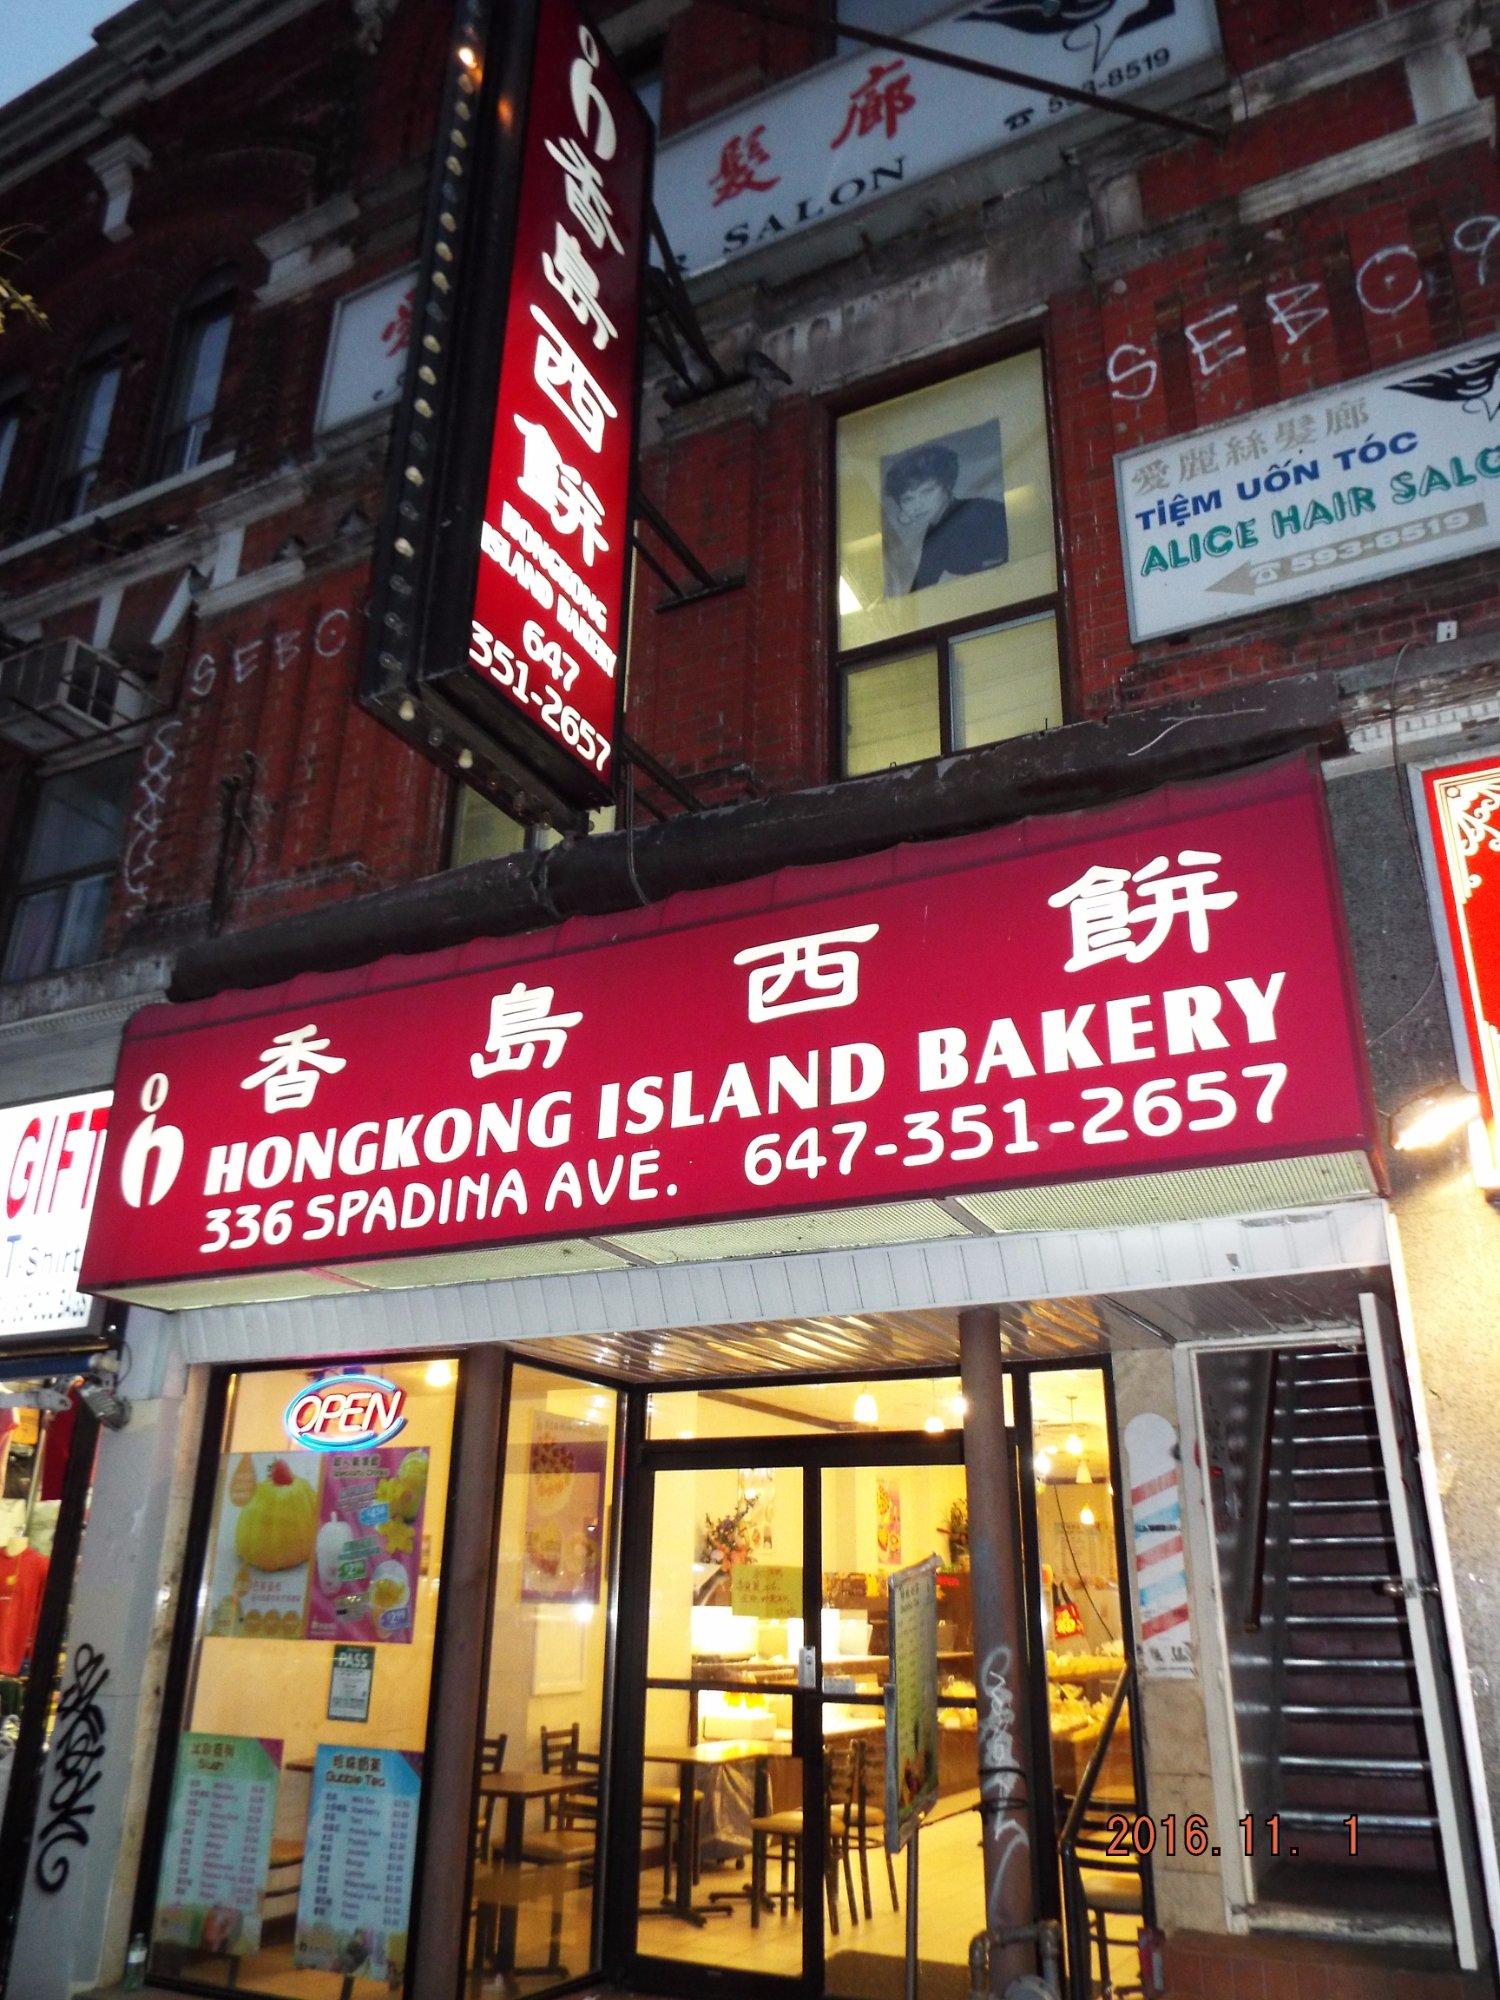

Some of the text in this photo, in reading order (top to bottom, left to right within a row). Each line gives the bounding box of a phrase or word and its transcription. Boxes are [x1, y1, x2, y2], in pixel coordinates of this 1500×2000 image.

[1048, 47, 1170, 114] 53-8519
[722, 156, 909, 255] SALON
[1333, 431, 1419, 472] TÓC
[1141, 517, 1260, 576] ALICE
[1271, 485, 1377, 540] HAIR
[1289, 510, 1472, 573] 593-8519
[468, 619, 612, 772] 351-2657
[522, 619, 580, 692] 647
[202, 971, 1287, 1197] HONGKONG ISLAND BAKERY
[743, 1061, 1289, 1187] 647-351-2657
[199, 1149, 679, 1254] 336 SPADINA AVE.
[287, 1389, 404, 1434] OPEN
[337, 1651, 369, 1669] PASS
